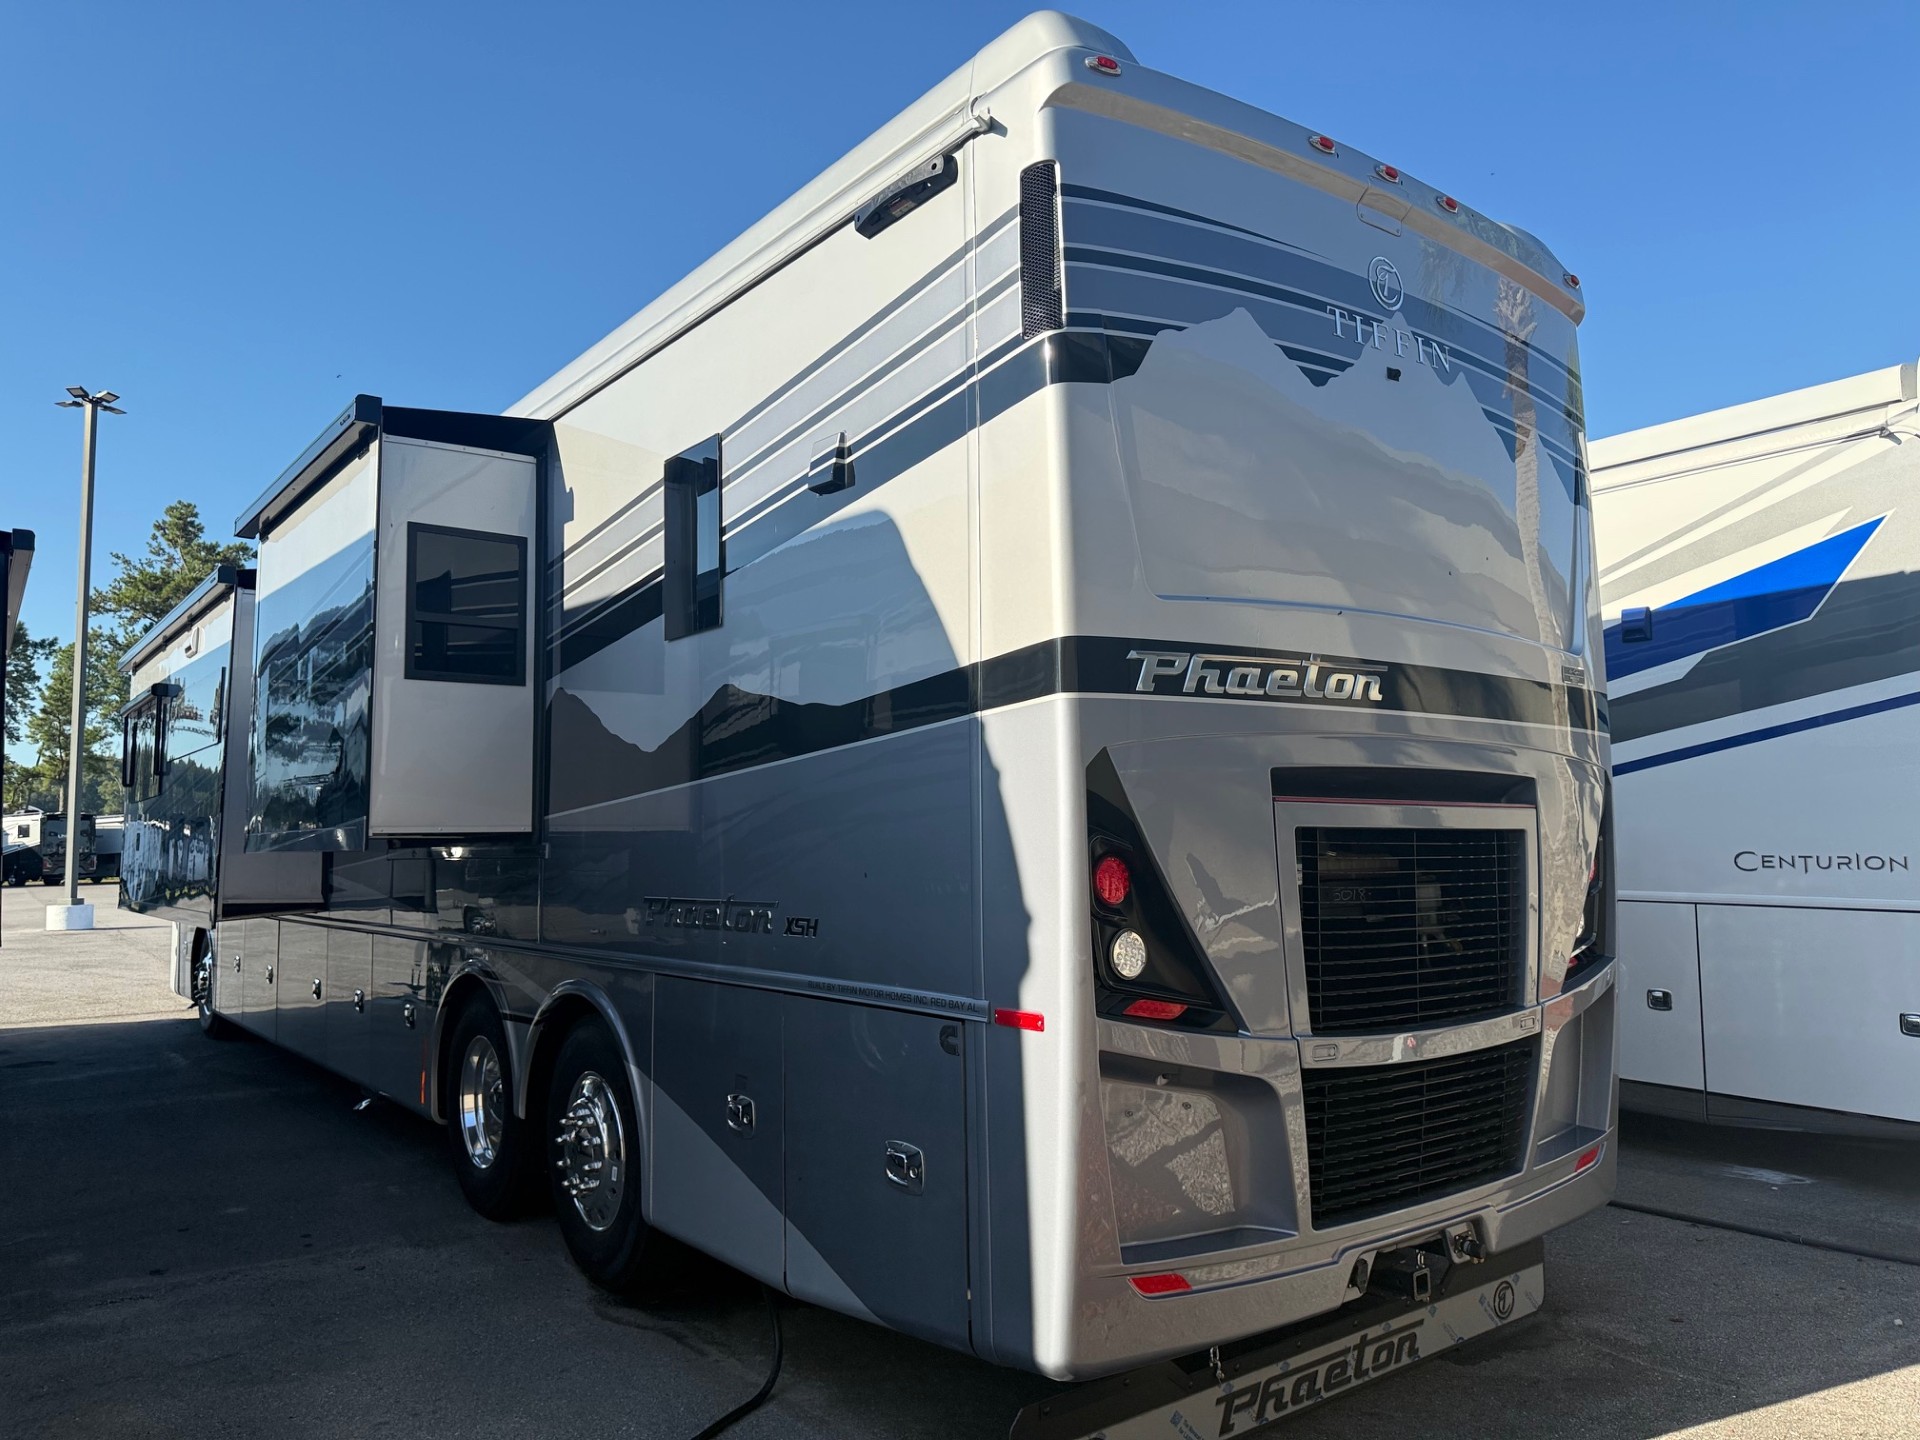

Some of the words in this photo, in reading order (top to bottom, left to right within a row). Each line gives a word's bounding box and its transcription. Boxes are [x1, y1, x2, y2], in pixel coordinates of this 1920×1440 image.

[1326, 305, 1451, 374] TIFFIN
[1125, 650, 1389, 702] Phaeton
[644, 895, 779, 934] Phaeton
[782, 916, 819, 938] XSH
[808, 980, 826, 989] BUILT
[827, 983, 836, 991] BY
[837, 985, 858, 995] TIFFIN
[858, 988, 884, 999] MOTOR
[885, 991, 912, 1003] HOMES
[930, 997, 946, 1008] RED
[948, 1000, 966, 1010] BAY
[1215, 1318, 1425, 1438] Phaeton
